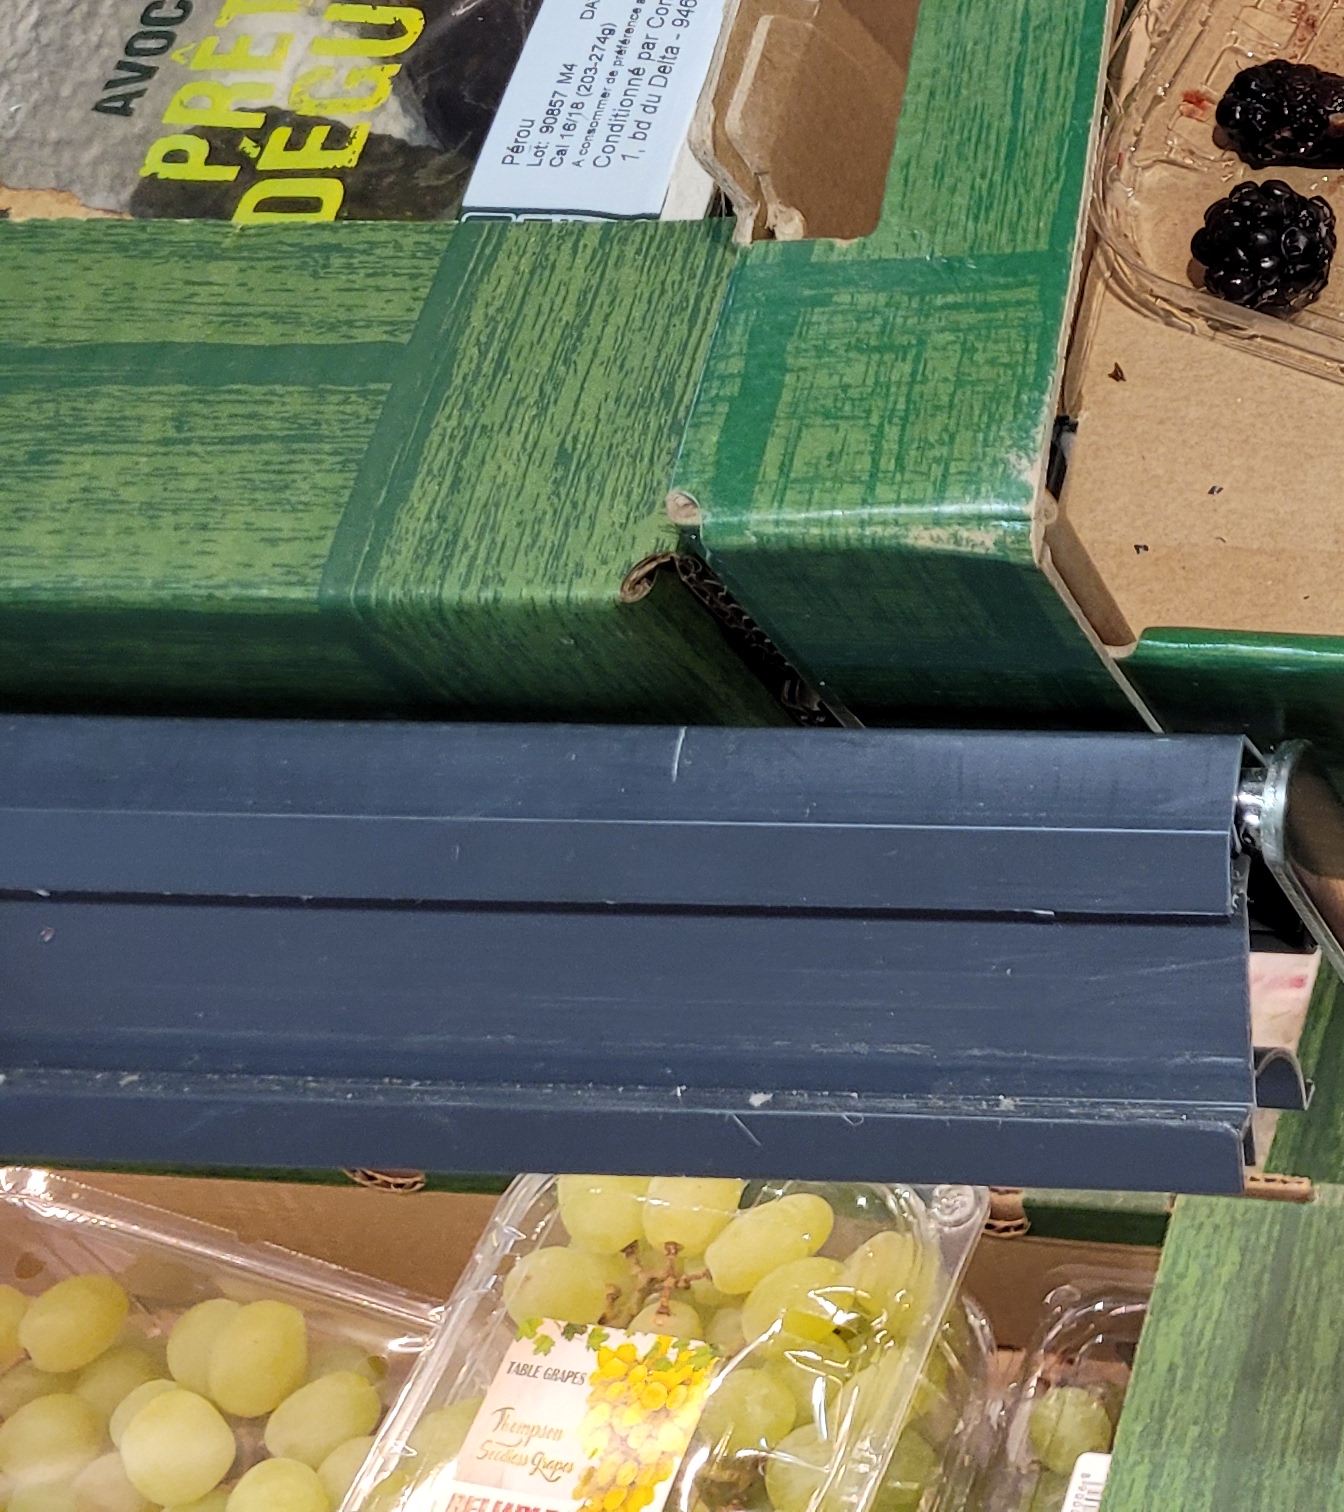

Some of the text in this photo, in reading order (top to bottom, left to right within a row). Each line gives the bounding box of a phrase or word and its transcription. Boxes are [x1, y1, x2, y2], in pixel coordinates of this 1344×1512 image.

[580, 86, 611, 156] consommer
[605, 70, 617, 85] de
[613, 5, 642, 67] préférence
[648, 45, 681, 89] Delta
[526, 63, 577, 168] Lot: 90857 M4
[549, 22, 618, 168] Cal 16/18 (203-274g)
[593, 66, 646, 168] Conditionné
[638, 34, 659, 61] par
[641, 93, 663, 116] du
[501, 118, 536, 167] Pérou
[629, 120, 651, 143] bd
[506, 1361, 588, 1386] TABLE GRAPES
[491, 1406, 565, 1448] Thompson
